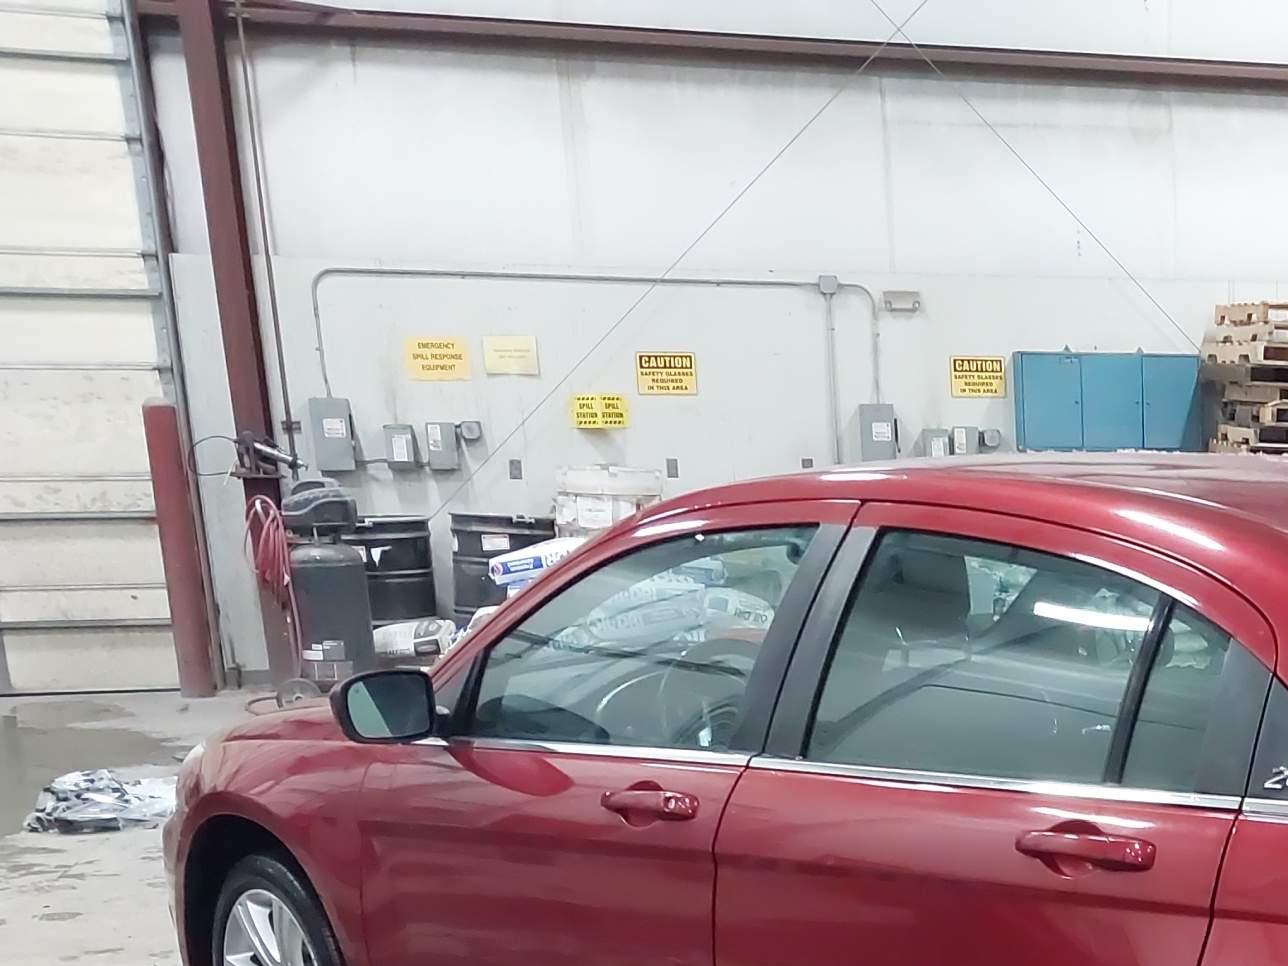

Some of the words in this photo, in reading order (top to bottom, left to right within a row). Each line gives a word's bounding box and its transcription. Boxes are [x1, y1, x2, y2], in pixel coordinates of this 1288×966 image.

[417, 342, 455, 350] EMERGENCY
[412, 353, 430, 361] SPILL
[430, 353, 463, 361] RESPONSE
[641, 356, 691, 368] CAUTION
[955, 360, 1001, 372] CAUTION
[578, 402, 593, 410] SPILL
[604, 402, 620, 410] SPILL
